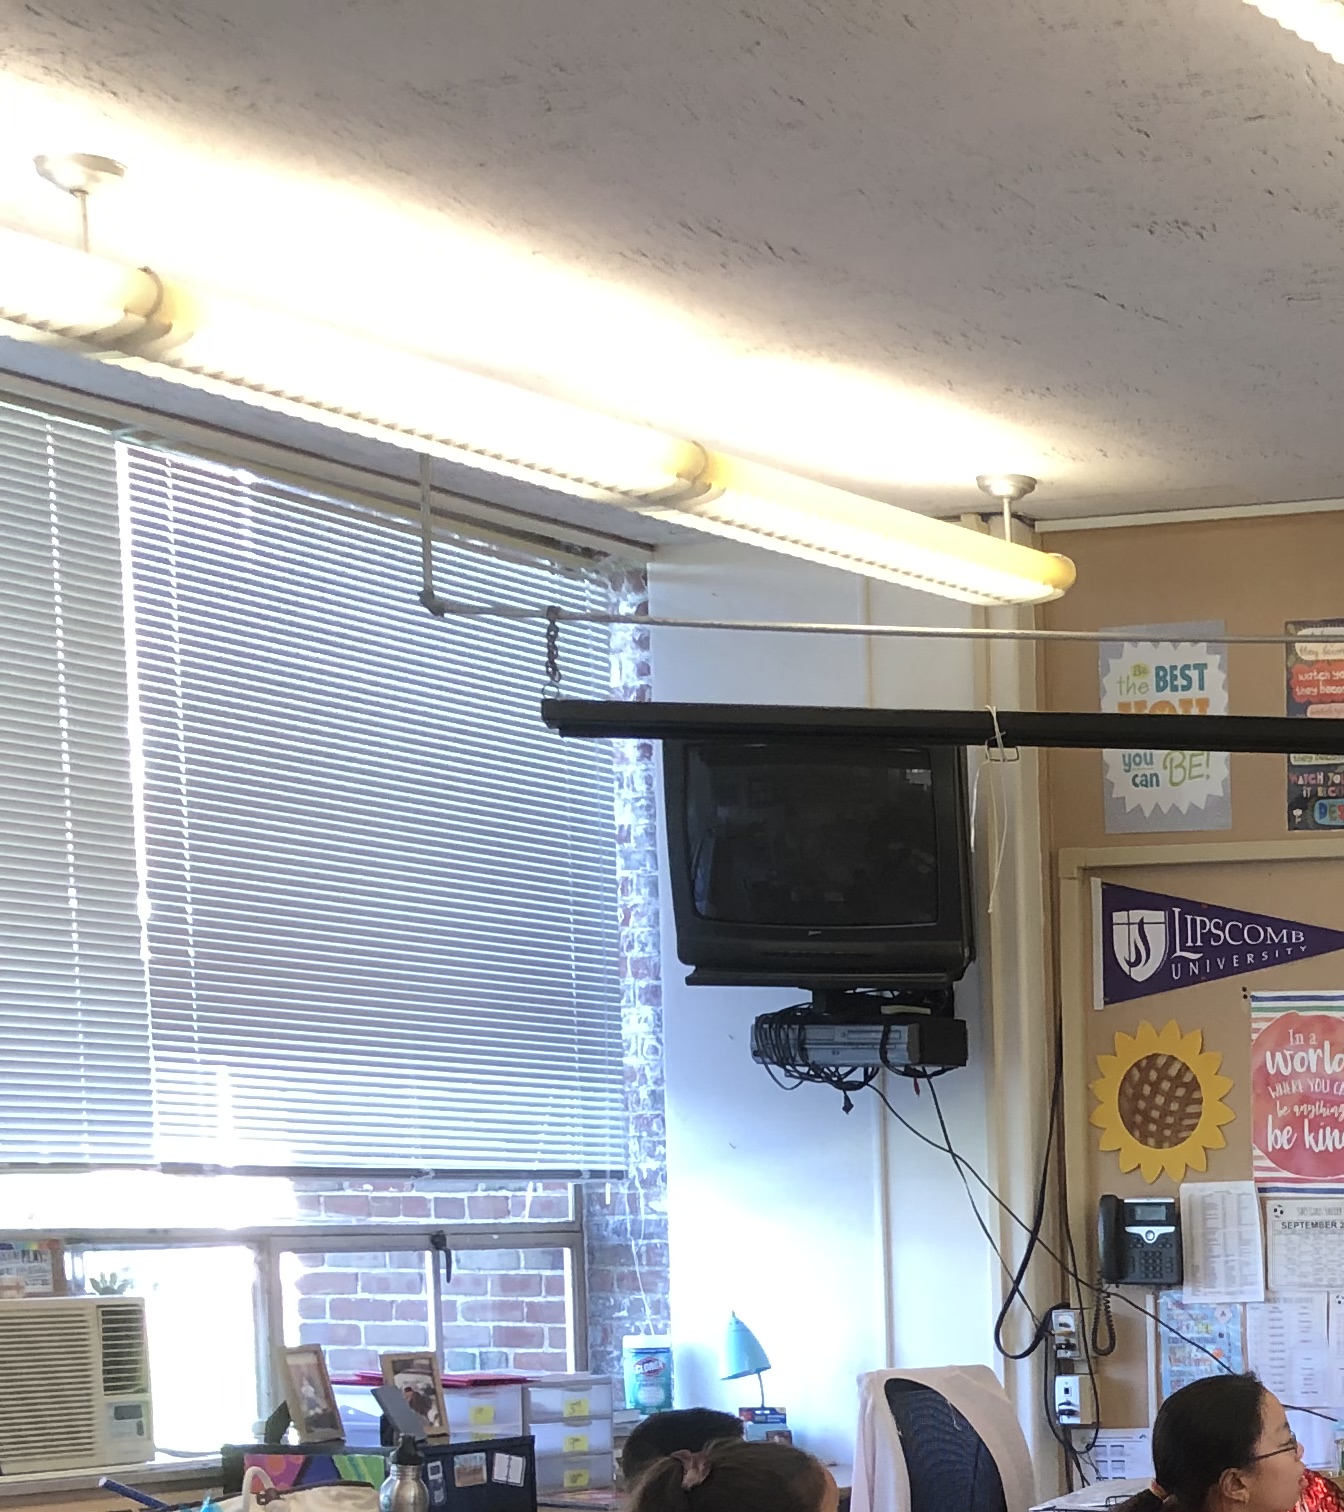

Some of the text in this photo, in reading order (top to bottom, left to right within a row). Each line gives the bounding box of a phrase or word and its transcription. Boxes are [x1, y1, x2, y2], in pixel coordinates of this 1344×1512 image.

[1117, 663, 1208, 696] the BEST
[1132, 664, 1148, 677] Be
[1121, 751, 1160, 788] you can
[1163, 750, 1210, 787] BE!
[1170, 907, 1306, 960] LIPSCOMB
[1171, 945, 1307, 980] UNIVERSITY
[1288, 1029, 1318, 1046] In a
[1268, 1078, 1304, 1100] WHERE
[1307, 1078, 1331, 1095] YOU
[1276, 1100, 1290, 1117] be
[1267, 1115, 1298, 1152] be
[1281, 1221, 1338, 1230] SEPTEMBER
